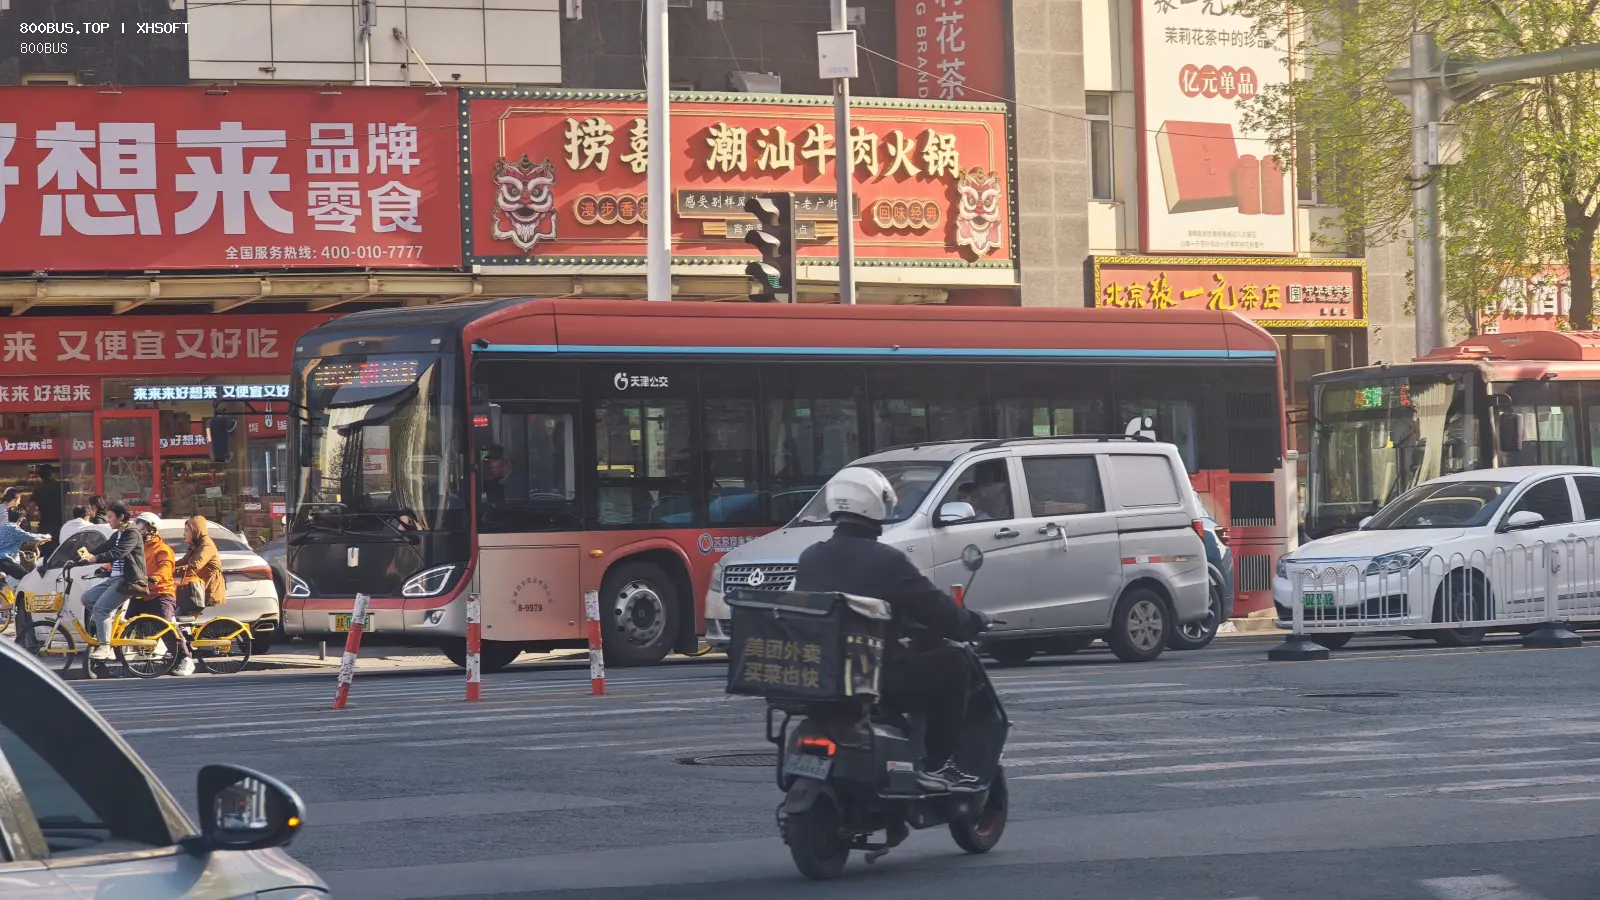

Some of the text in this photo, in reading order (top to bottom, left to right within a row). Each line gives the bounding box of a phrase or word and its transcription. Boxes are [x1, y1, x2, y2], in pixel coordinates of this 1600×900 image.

[1164, 27, 1269, 49] 茉莉花茶中的珍品
[916, 26, 929, 99] BRAND
[1182, 70, 1254, 95] 亿元单品
[306, 122, 420, 175] 品牌
[706, 121, 960, 179] 潮汕牛肉火锅
[0, 120, 294, 237] 想来
[307, 180, 423, 234] 零食
[878, 204, 939, 221] 回味经典
[225, 245, 423, 261] 全国服务热线: 400-010-7777
[1105, 272, 1283, 310] 北京张一元茶庄
[3, 331, 37, 362] 来
[133, 386, 218, 401] 来来来好想来
[630, 376, 669, 388] 天津公交
[170, 434, 206, 446] 好想来
[517, 604, 543, 612] 8-9979
[745, 637, 821, 664] 美团外卖
[744, 662, 820, 688] 买菜也快
